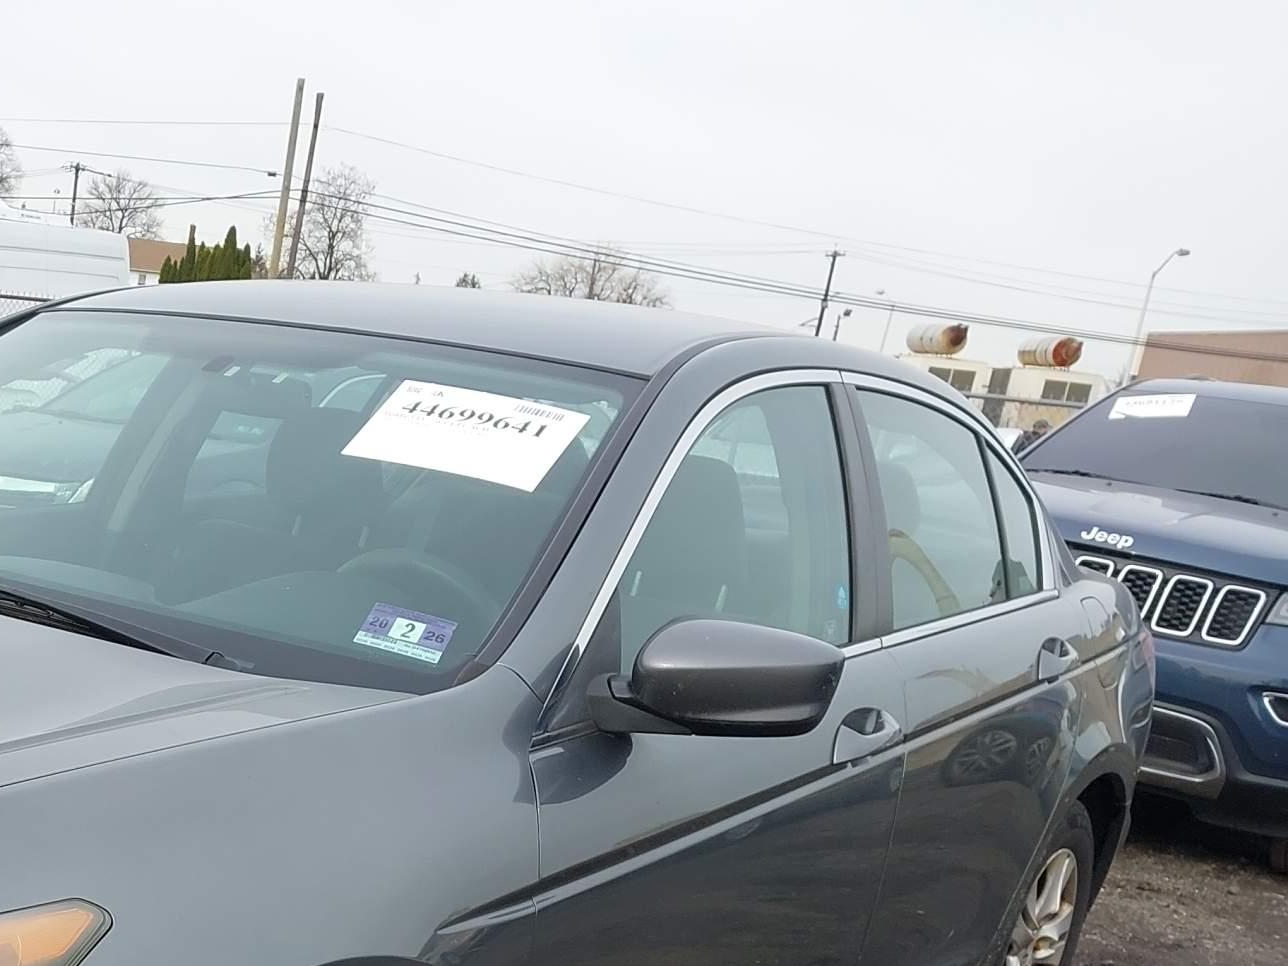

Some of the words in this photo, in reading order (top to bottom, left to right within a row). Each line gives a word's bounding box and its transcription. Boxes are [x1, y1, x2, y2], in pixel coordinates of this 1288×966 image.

[401, 401, 549, 438] 44699641
[1080, 526, 1134, 549] Jeep
[369, 616, 389, 629] 20
[400, 622, 416, 639] 2
[423, 631, 446, 644] 26
